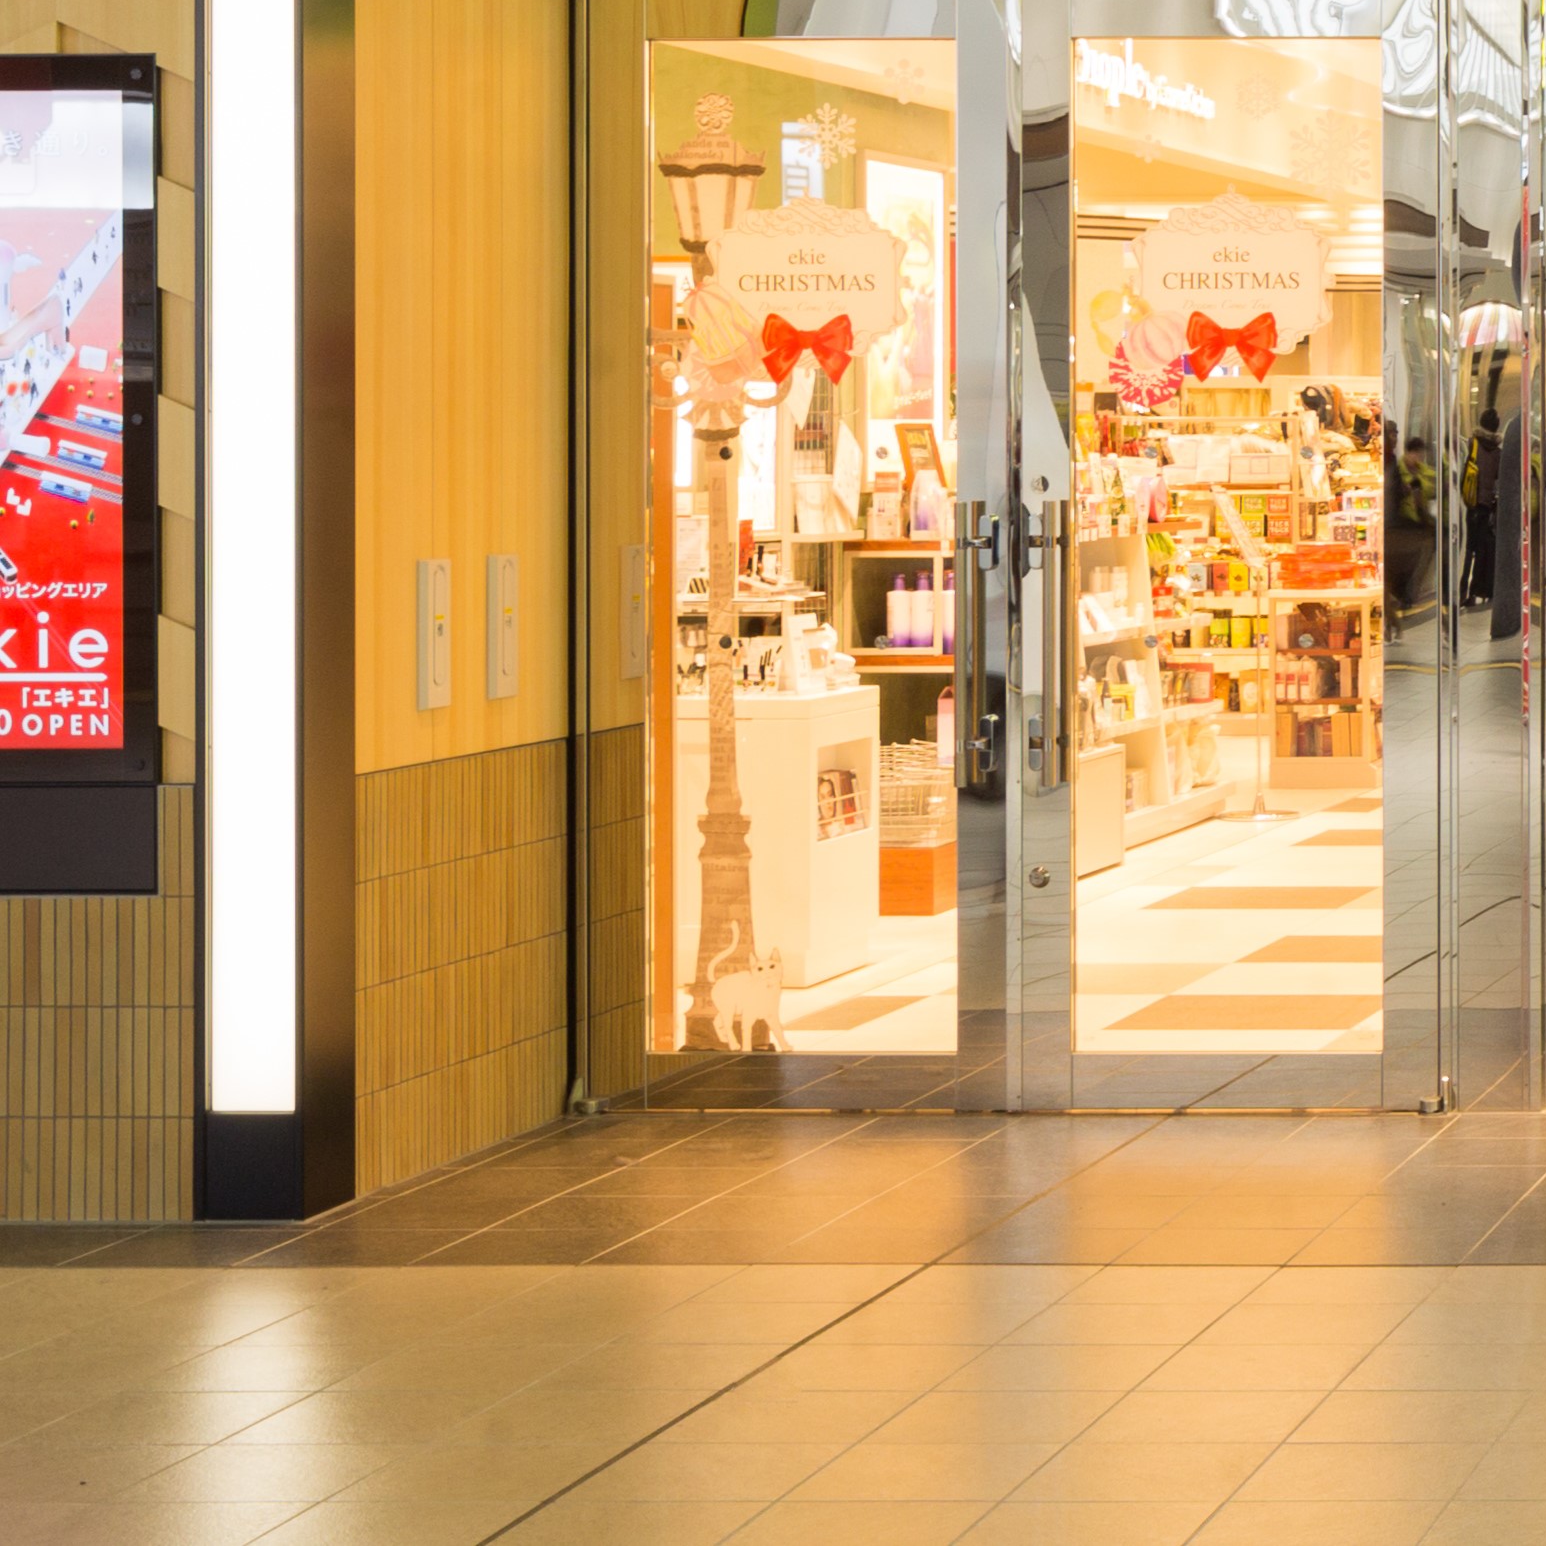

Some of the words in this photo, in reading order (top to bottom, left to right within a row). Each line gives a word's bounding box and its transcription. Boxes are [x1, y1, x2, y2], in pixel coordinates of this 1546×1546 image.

[788, 248, 826, 265] ekie
[1212, 246, 1251, 263] ekie
[738, 273, 876, 293] CHRISTMAS
[1162, 271, 1301, 291] CHRISTMAS
[2, 582, 108, 599] ッピングエリア
[22, 686, 109, 709] 「エキエ」
[22, 713, 110, 736] OPEN
